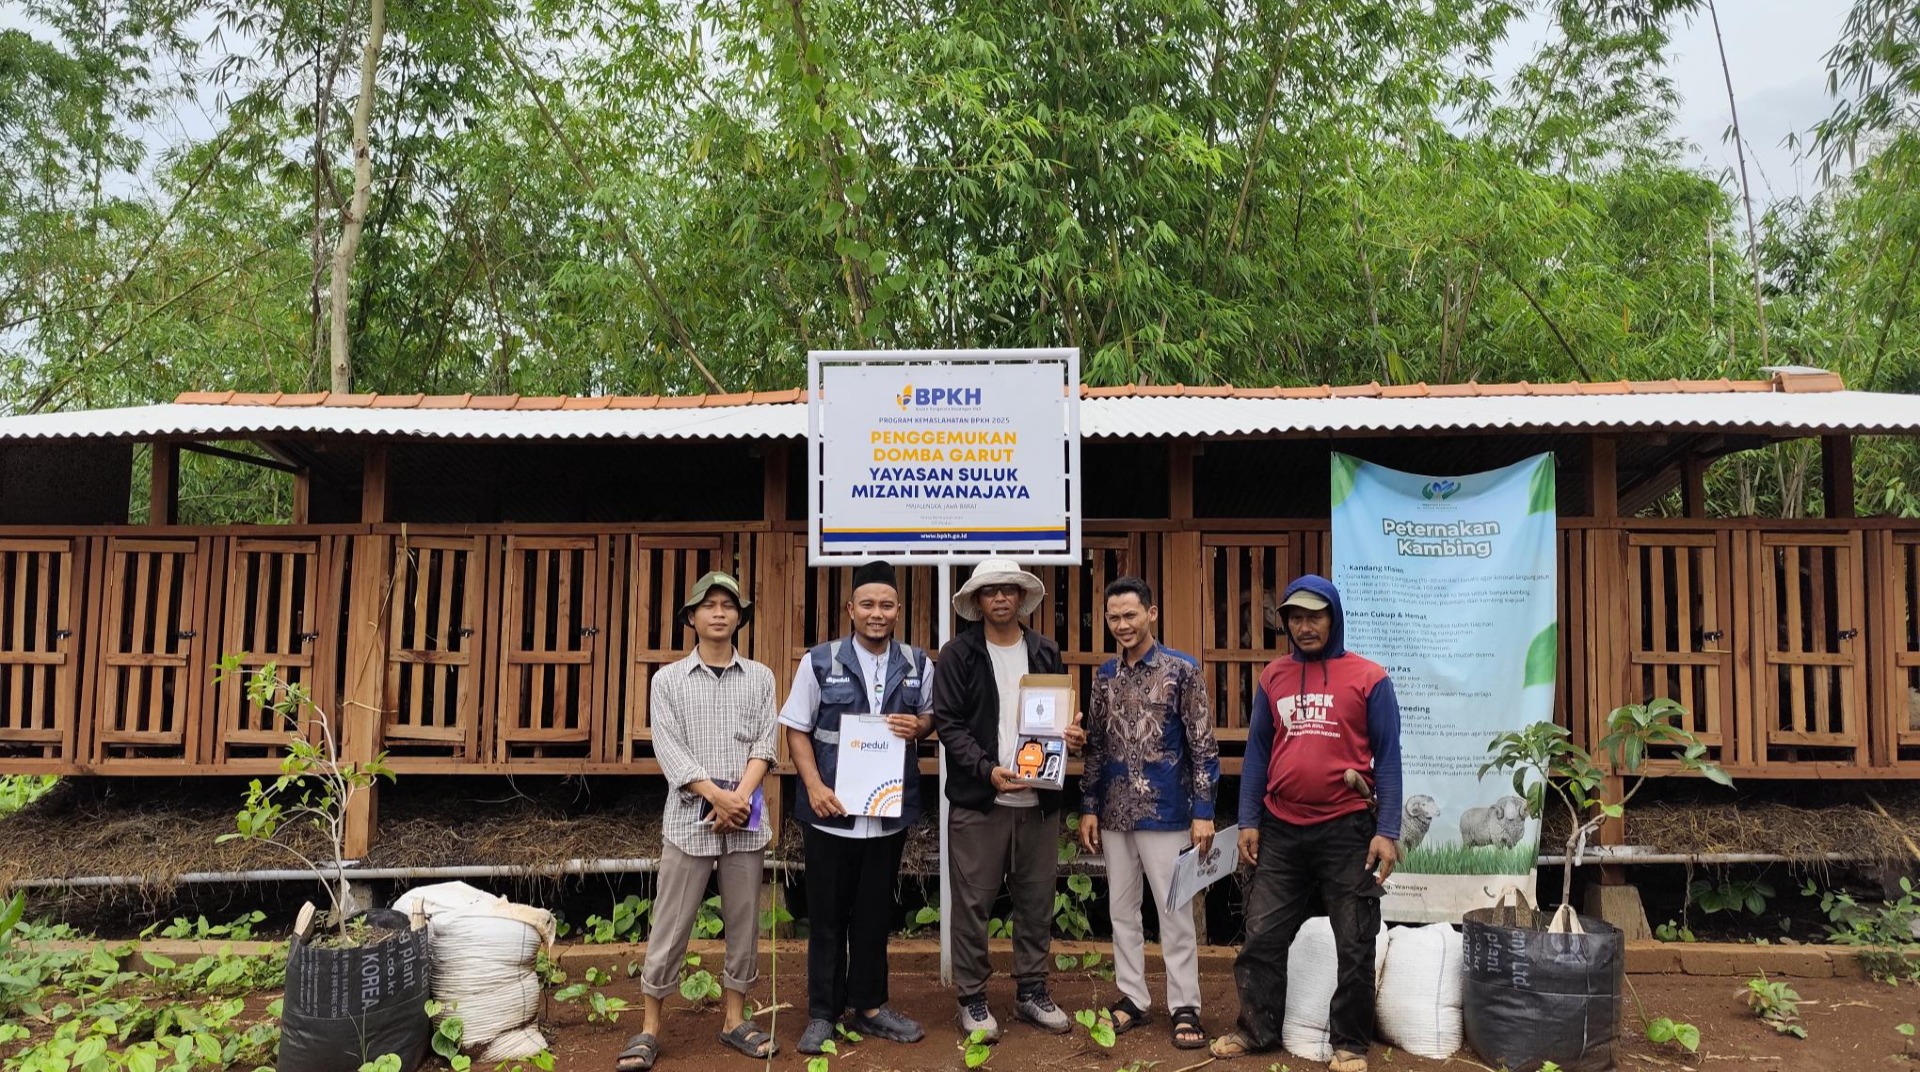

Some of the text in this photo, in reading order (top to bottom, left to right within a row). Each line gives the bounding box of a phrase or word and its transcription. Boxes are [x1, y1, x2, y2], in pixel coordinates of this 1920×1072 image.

[915, 387, 981, 405] BPKH
[870, 430, 1017, 445] PENGGEMUKAN
[873, 447, 1015, 463] DOMBA GARUT
[869, 467, 1019, 482] YAYASAN SULUK
[851, 484, 1030, 500] MIZANI WANAJAYA
[1382, 518, 1500, 538] Peternakan
[1397, 539, 1492, 559] Kambing
[1349, 565, 1383, 573] Kandang
[1370, 610, 1396, 619] Cukup
[1404, 612, 1427, 620] Hemat
[1397, 665, 1411, 673] Pas
[1296, 693, 1334, 708] SPEK
[1296, 706, 1327, 721] KULI
[1399, 705, 1431, 713] reeding
[1483, 931, 1503, 974] plant
[1507, 930, 1531, 990] any Ltd.
[386, 940, 397, 996] ci.co.kr
[398, 946, 417, 990] plant
[361, 952, 380, 1010] KOREA
